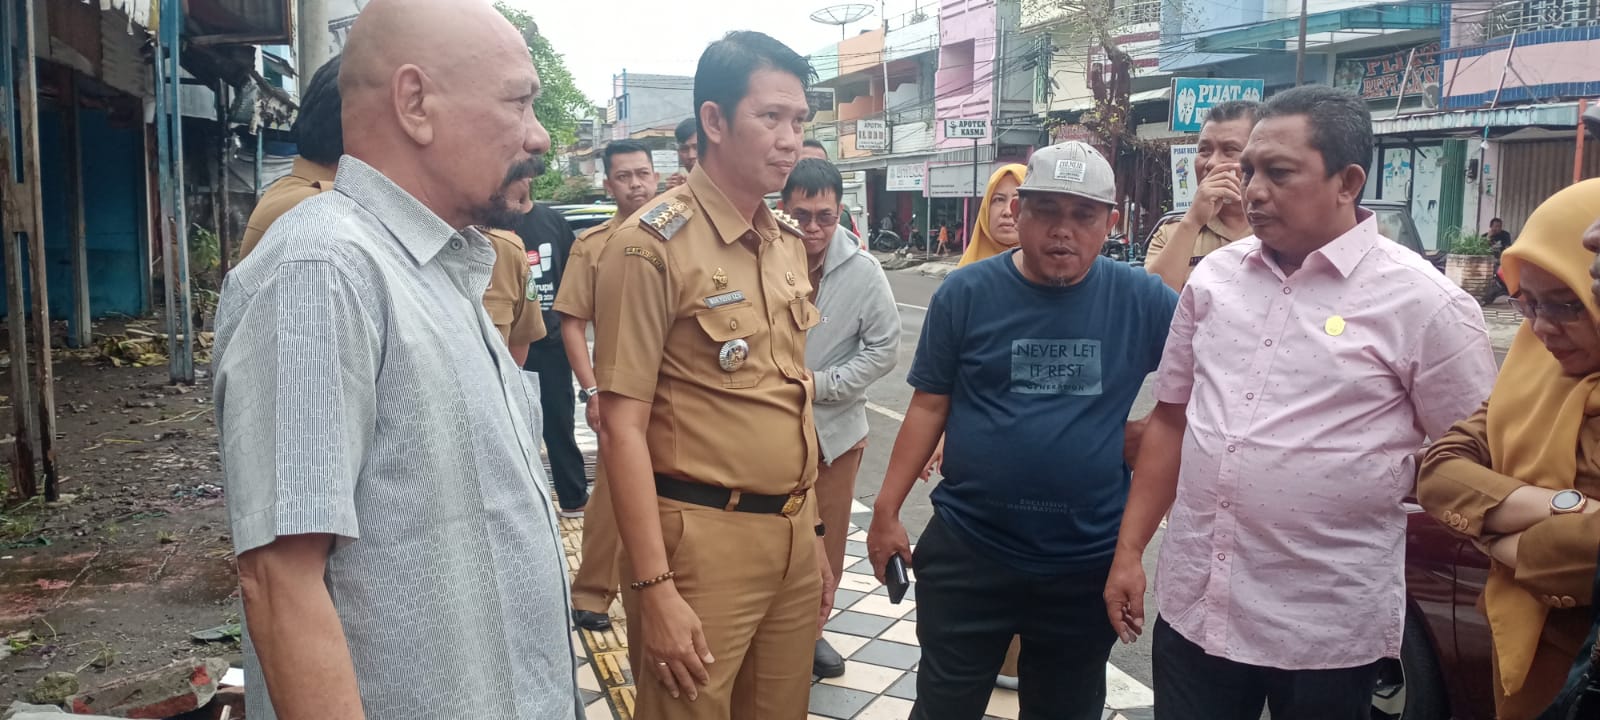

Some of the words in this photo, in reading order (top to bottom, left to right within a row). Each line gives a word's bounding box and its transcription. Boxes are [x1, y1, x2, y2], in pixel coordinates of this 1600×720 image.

[1197, 85, 1242, 103] PIJAT
[958, 120, 986, 128] APOTEK
[960, 128, 985, 136] KASMA
[1016, 343, 1068, 358] NEVER
[1073, 343, 1097, 358] LET
[1030, 364, 1042, 377] IT
[1048, 363, 1085, 377] REST
